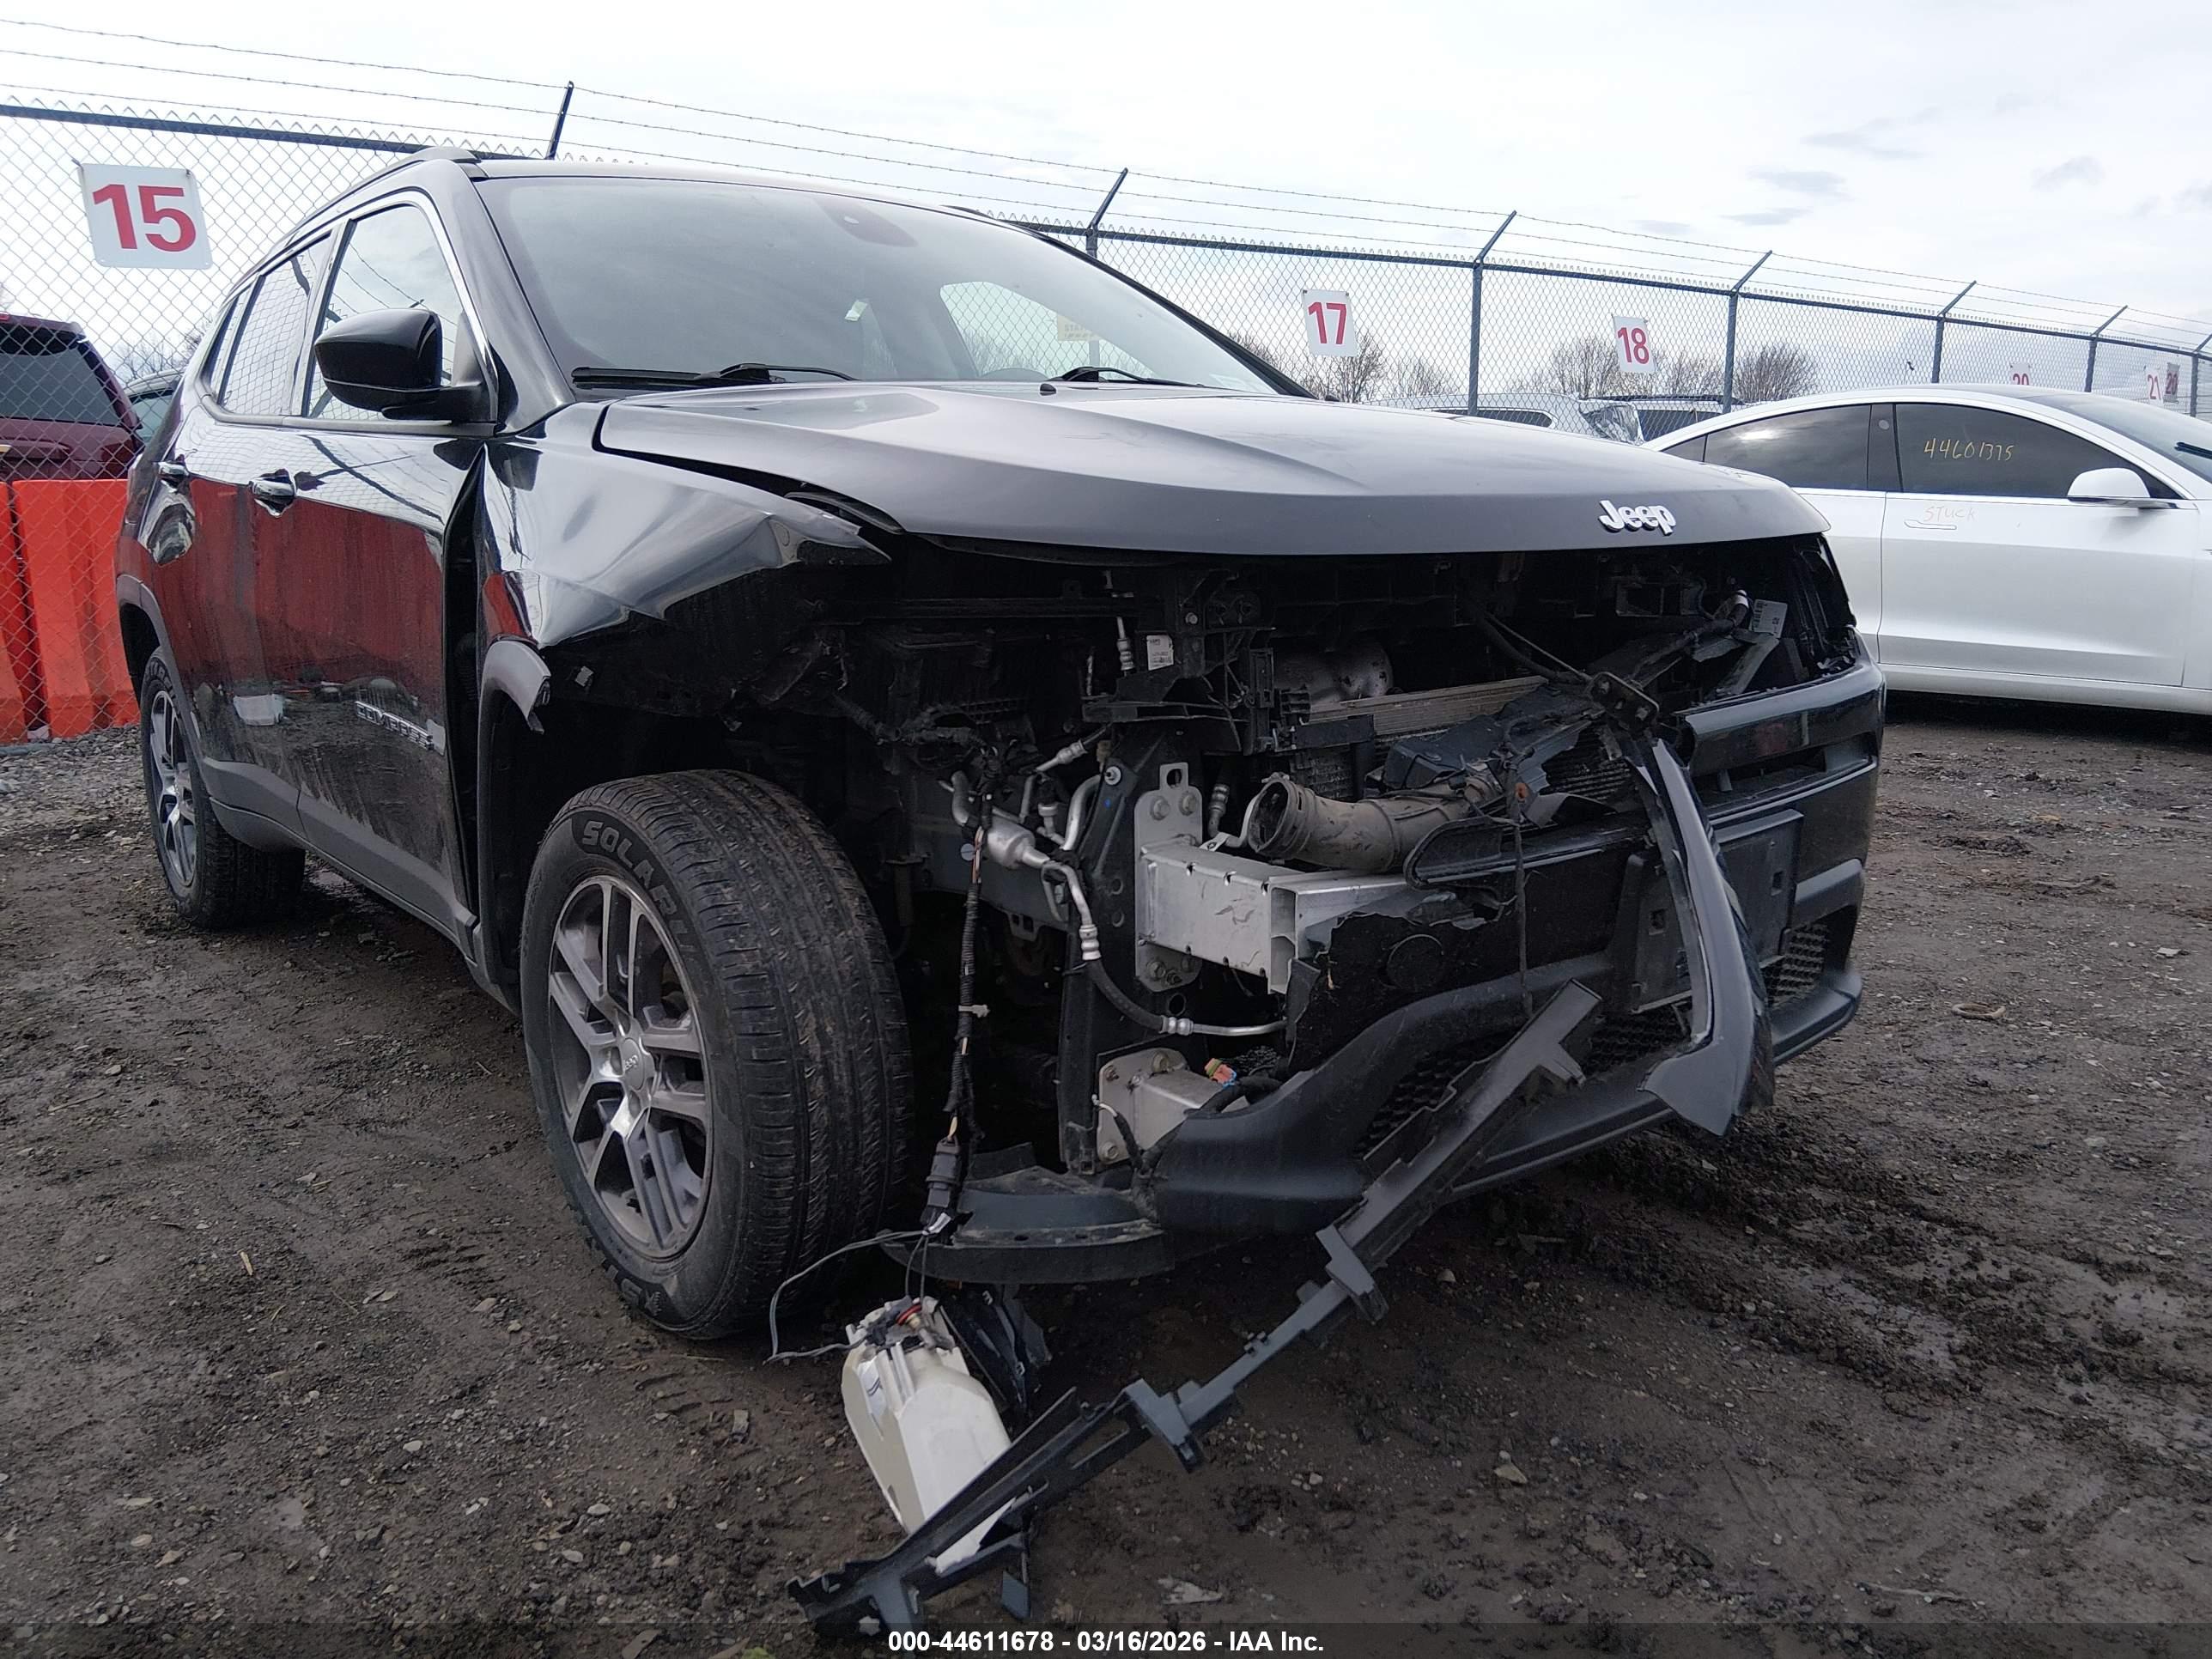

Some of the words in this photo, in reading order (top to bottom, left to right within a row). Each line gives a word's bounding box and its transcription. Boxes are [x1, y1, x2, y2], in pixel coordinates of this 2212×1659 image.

[93, 184, 197, 252] 15
[1308, 301, 1347, 344] 17
[1618, 326, 1650, 364] 18
[2147, 374, 2161, 400] 21
[1923, 437, 2014, 461] 44601375
[1598, 500, 1676, 536] Jeep
